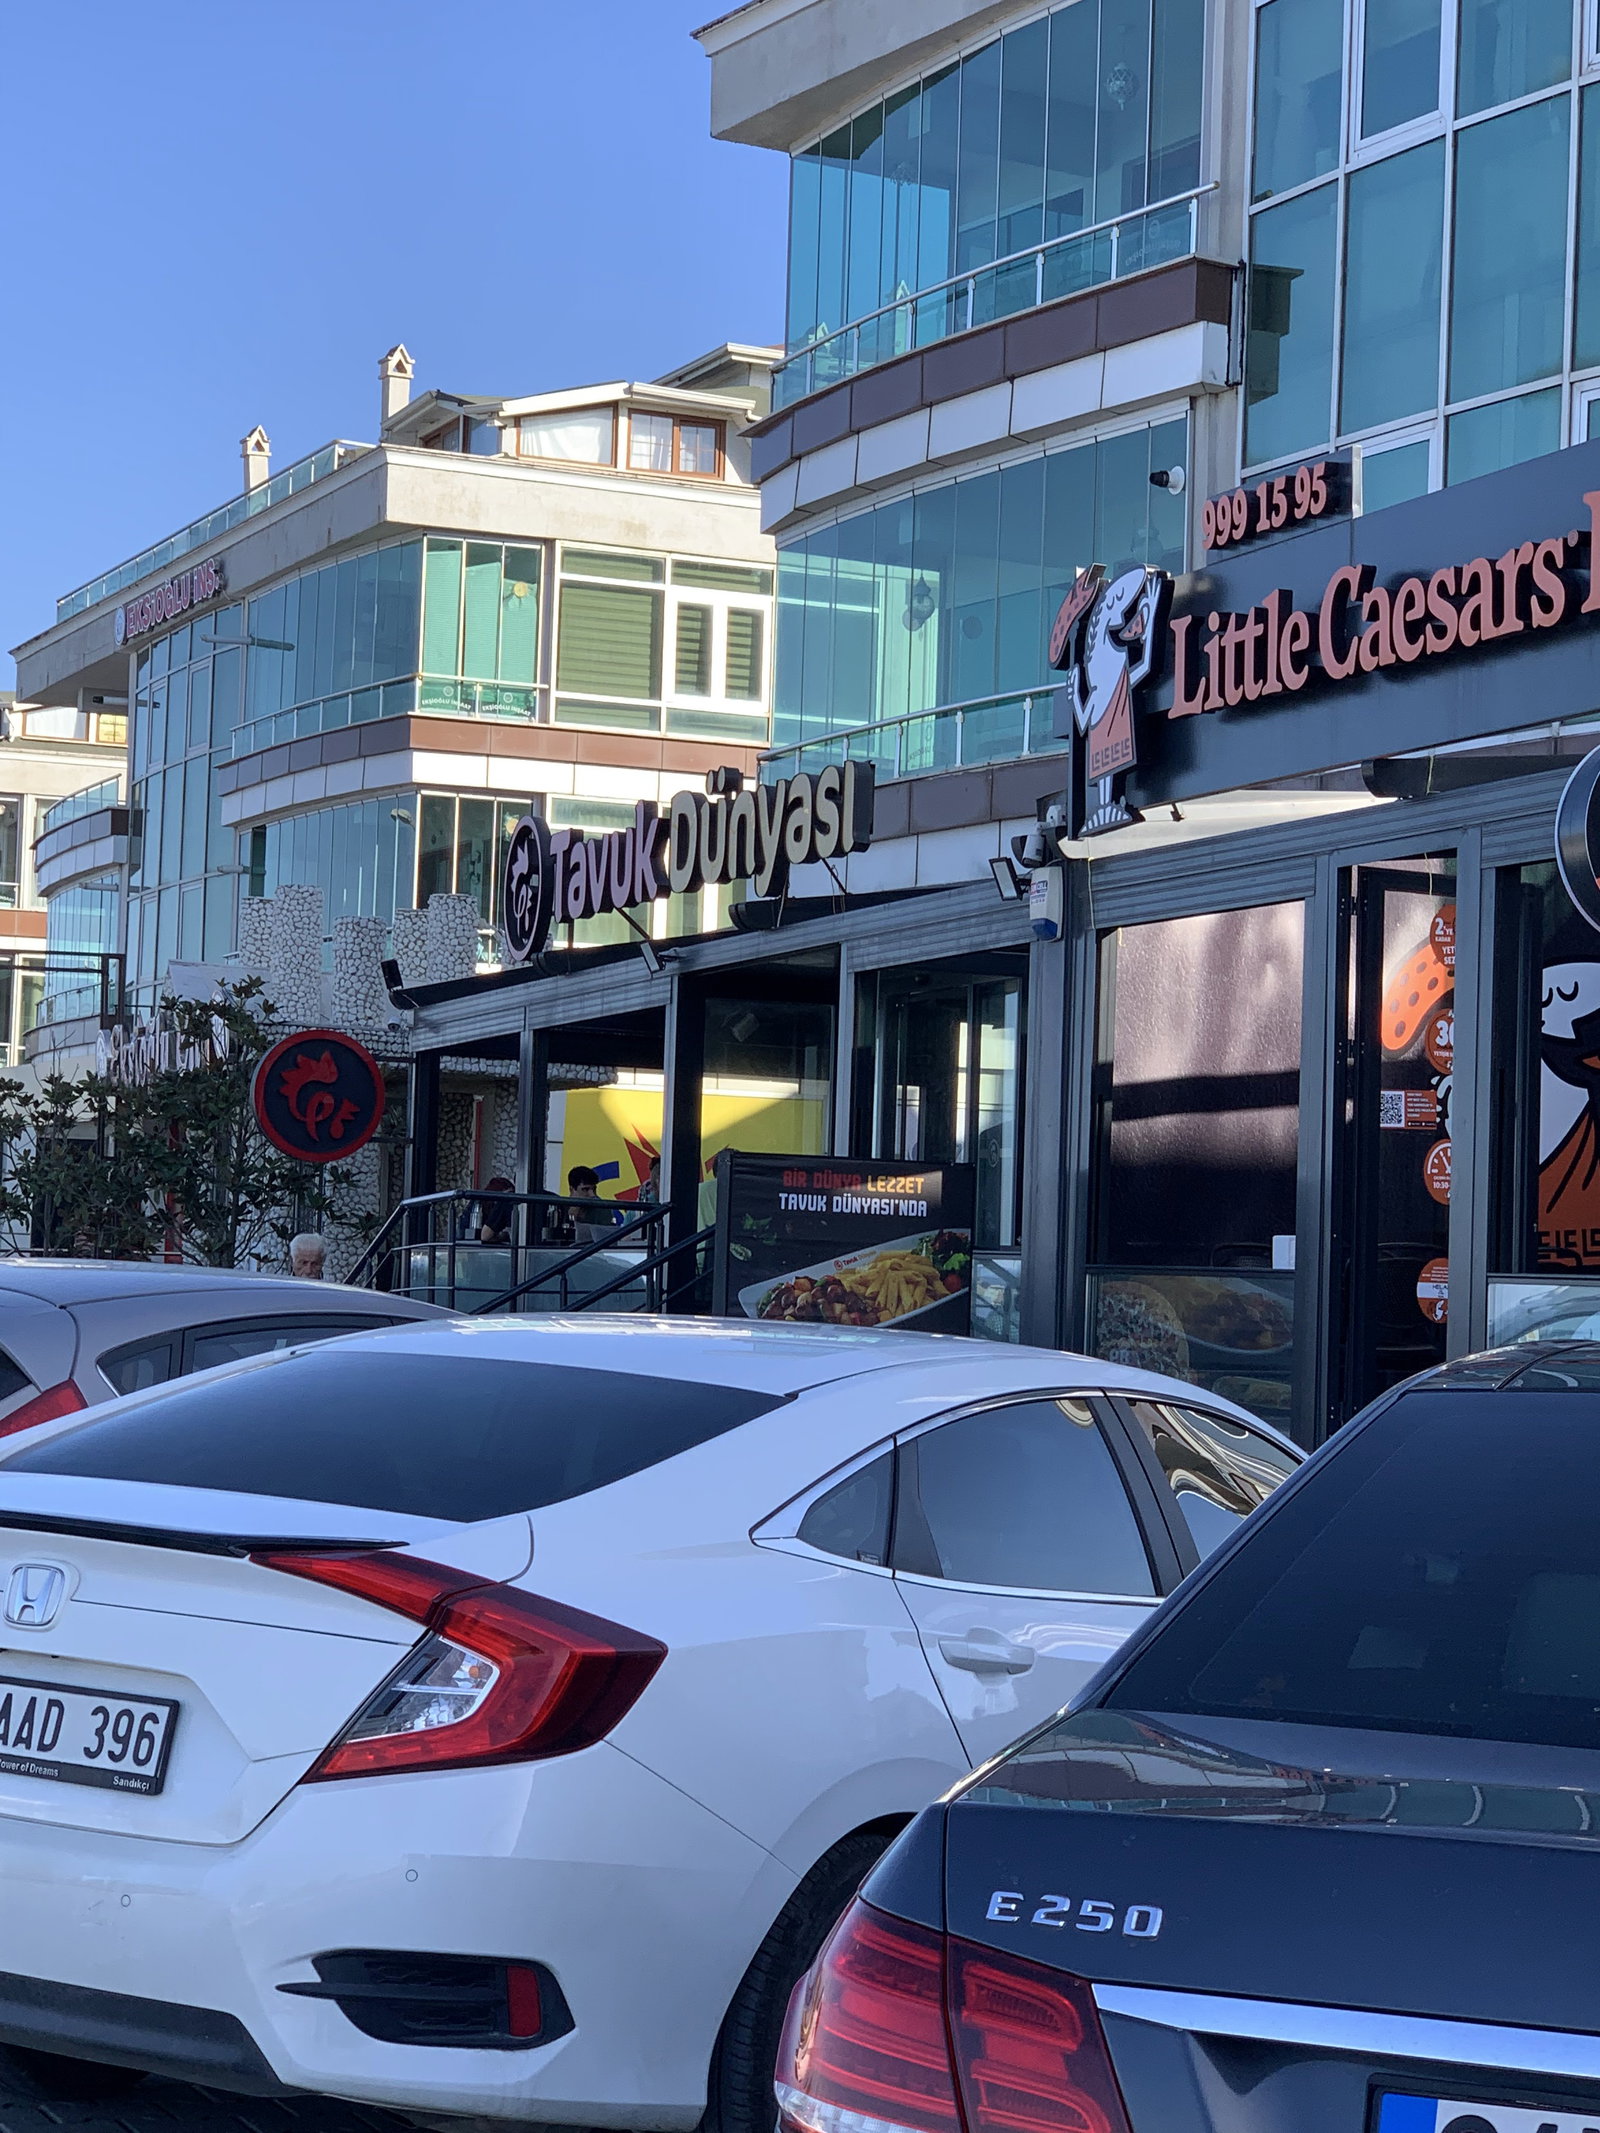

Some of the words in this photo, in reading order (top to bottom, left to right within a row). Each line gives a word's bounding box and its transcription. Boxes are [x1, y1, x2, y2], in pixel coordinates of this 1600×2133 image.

[1202, 488, 1248, 551] 999
[1256, 475, 1288, 534] 15
[1293, 461, 1328, 520] 95
[1167, 588, 1310, 720] Little
[1318, 537, 1566, 681] Caesars
[550, 799, 661, 924] Tavuk
[778, 1192, 827, 1213] TAVUK
[832, 1193, 928, 1218] DÜNYASI'NDA
[783, 1169, 808, 1188] BİR
[812, 1170, 862, 1191] DÜNYA
[867, 1175, 925, 1194] LEZZET
[83, 1705, 161, 1768] 396
[20, 1762, 30, 1773] of
[29, 1763, 59, 1778] Dreams
[984, 1890, 1025, 1923] E
[1031, 1893, 1163, 1938] 250
